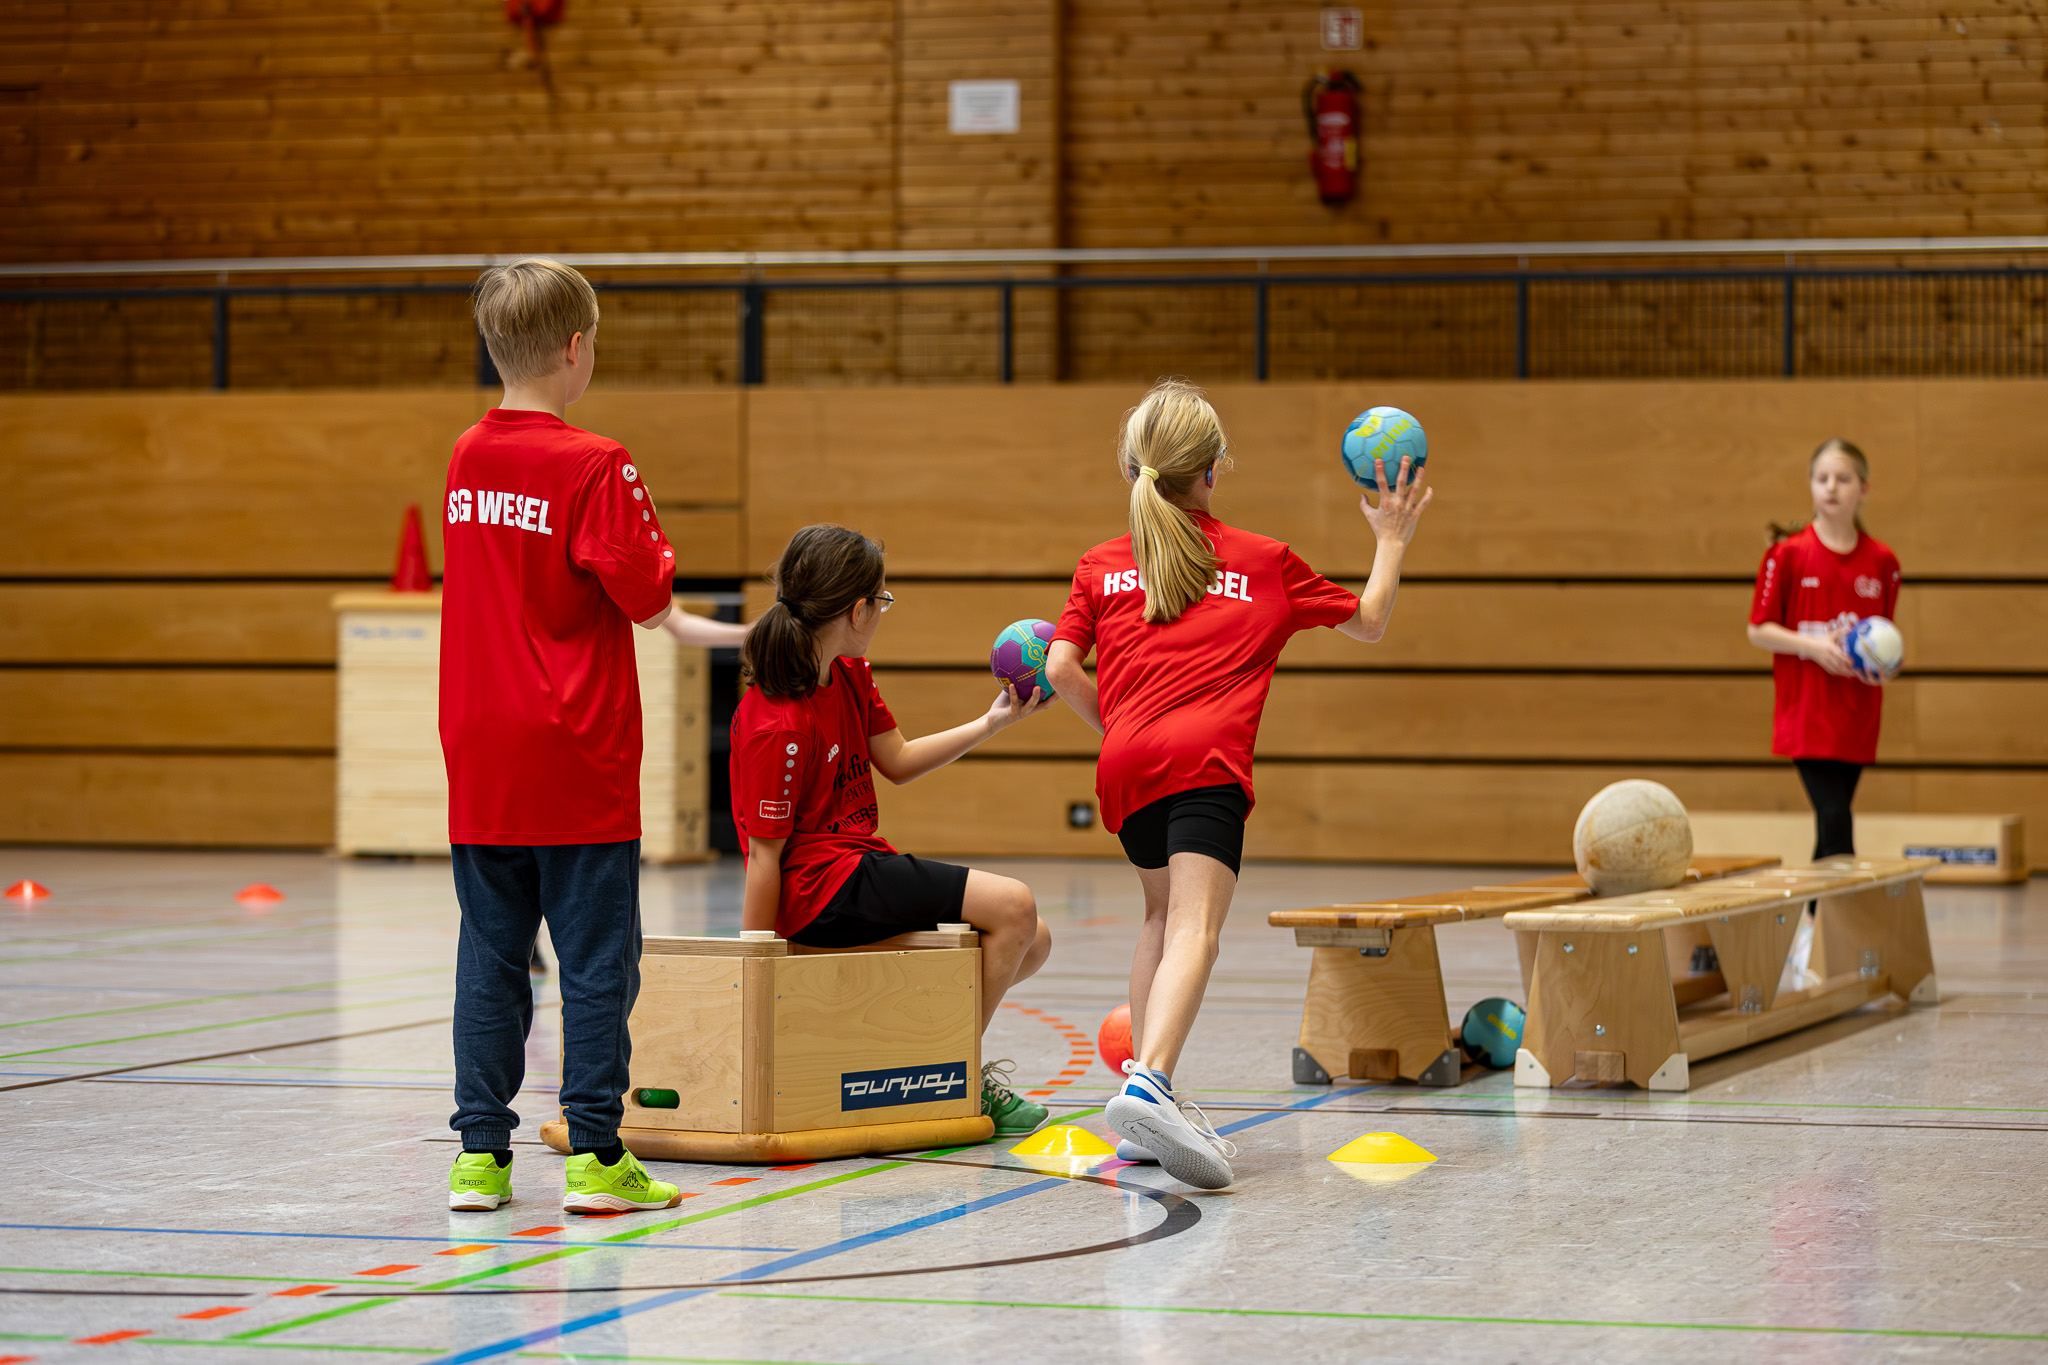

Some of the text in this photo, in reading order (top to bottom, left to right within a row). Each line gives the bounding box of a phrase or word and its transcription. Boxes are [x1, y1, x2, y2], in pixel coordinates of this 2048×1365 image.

[447, 488, 553, 536] SG WESEL
[1207, 570, 1253, 602] SEL
[459, 1178, 488, 1187] Kappa
[567, 1180, 587, 1188] appa
